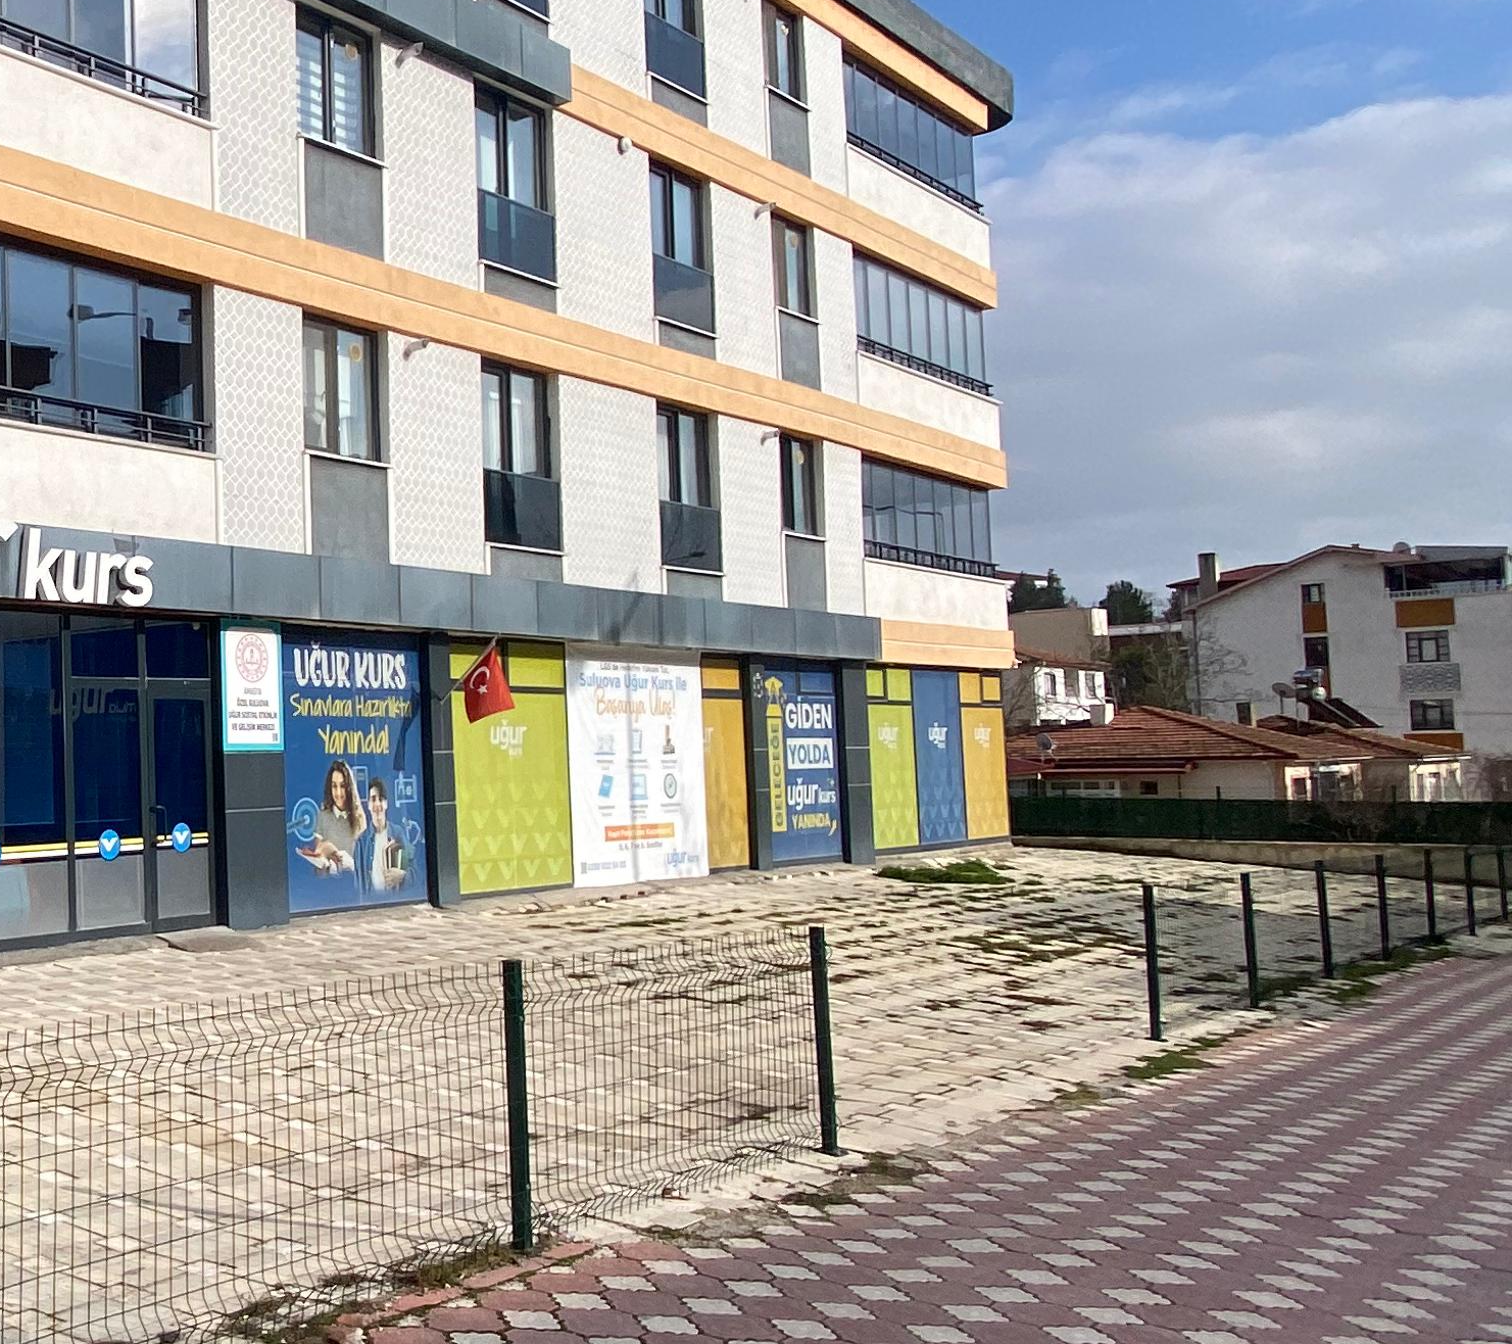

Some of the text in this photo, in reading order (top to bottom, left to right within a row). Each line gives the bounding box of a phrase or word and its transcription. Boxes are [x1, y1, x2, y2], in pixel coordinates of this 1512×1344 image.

[21, 527, 155, 608] kurs
[293, 640, 407, 690] UĞUR KURS
[624, 673, 649, 692] Uğur
[650, 675, 674, 691] Kurs
[289, 693, 353, 717] Sınavlara
[785, 696, 833, 730] GİDEN
[317, 723, 390, 756] Yanında!
[788, 742, 832, 765] YOLDA
[770, 722, 784, 828] GELECEĞE
[787, 777, 819, 811] uğur
